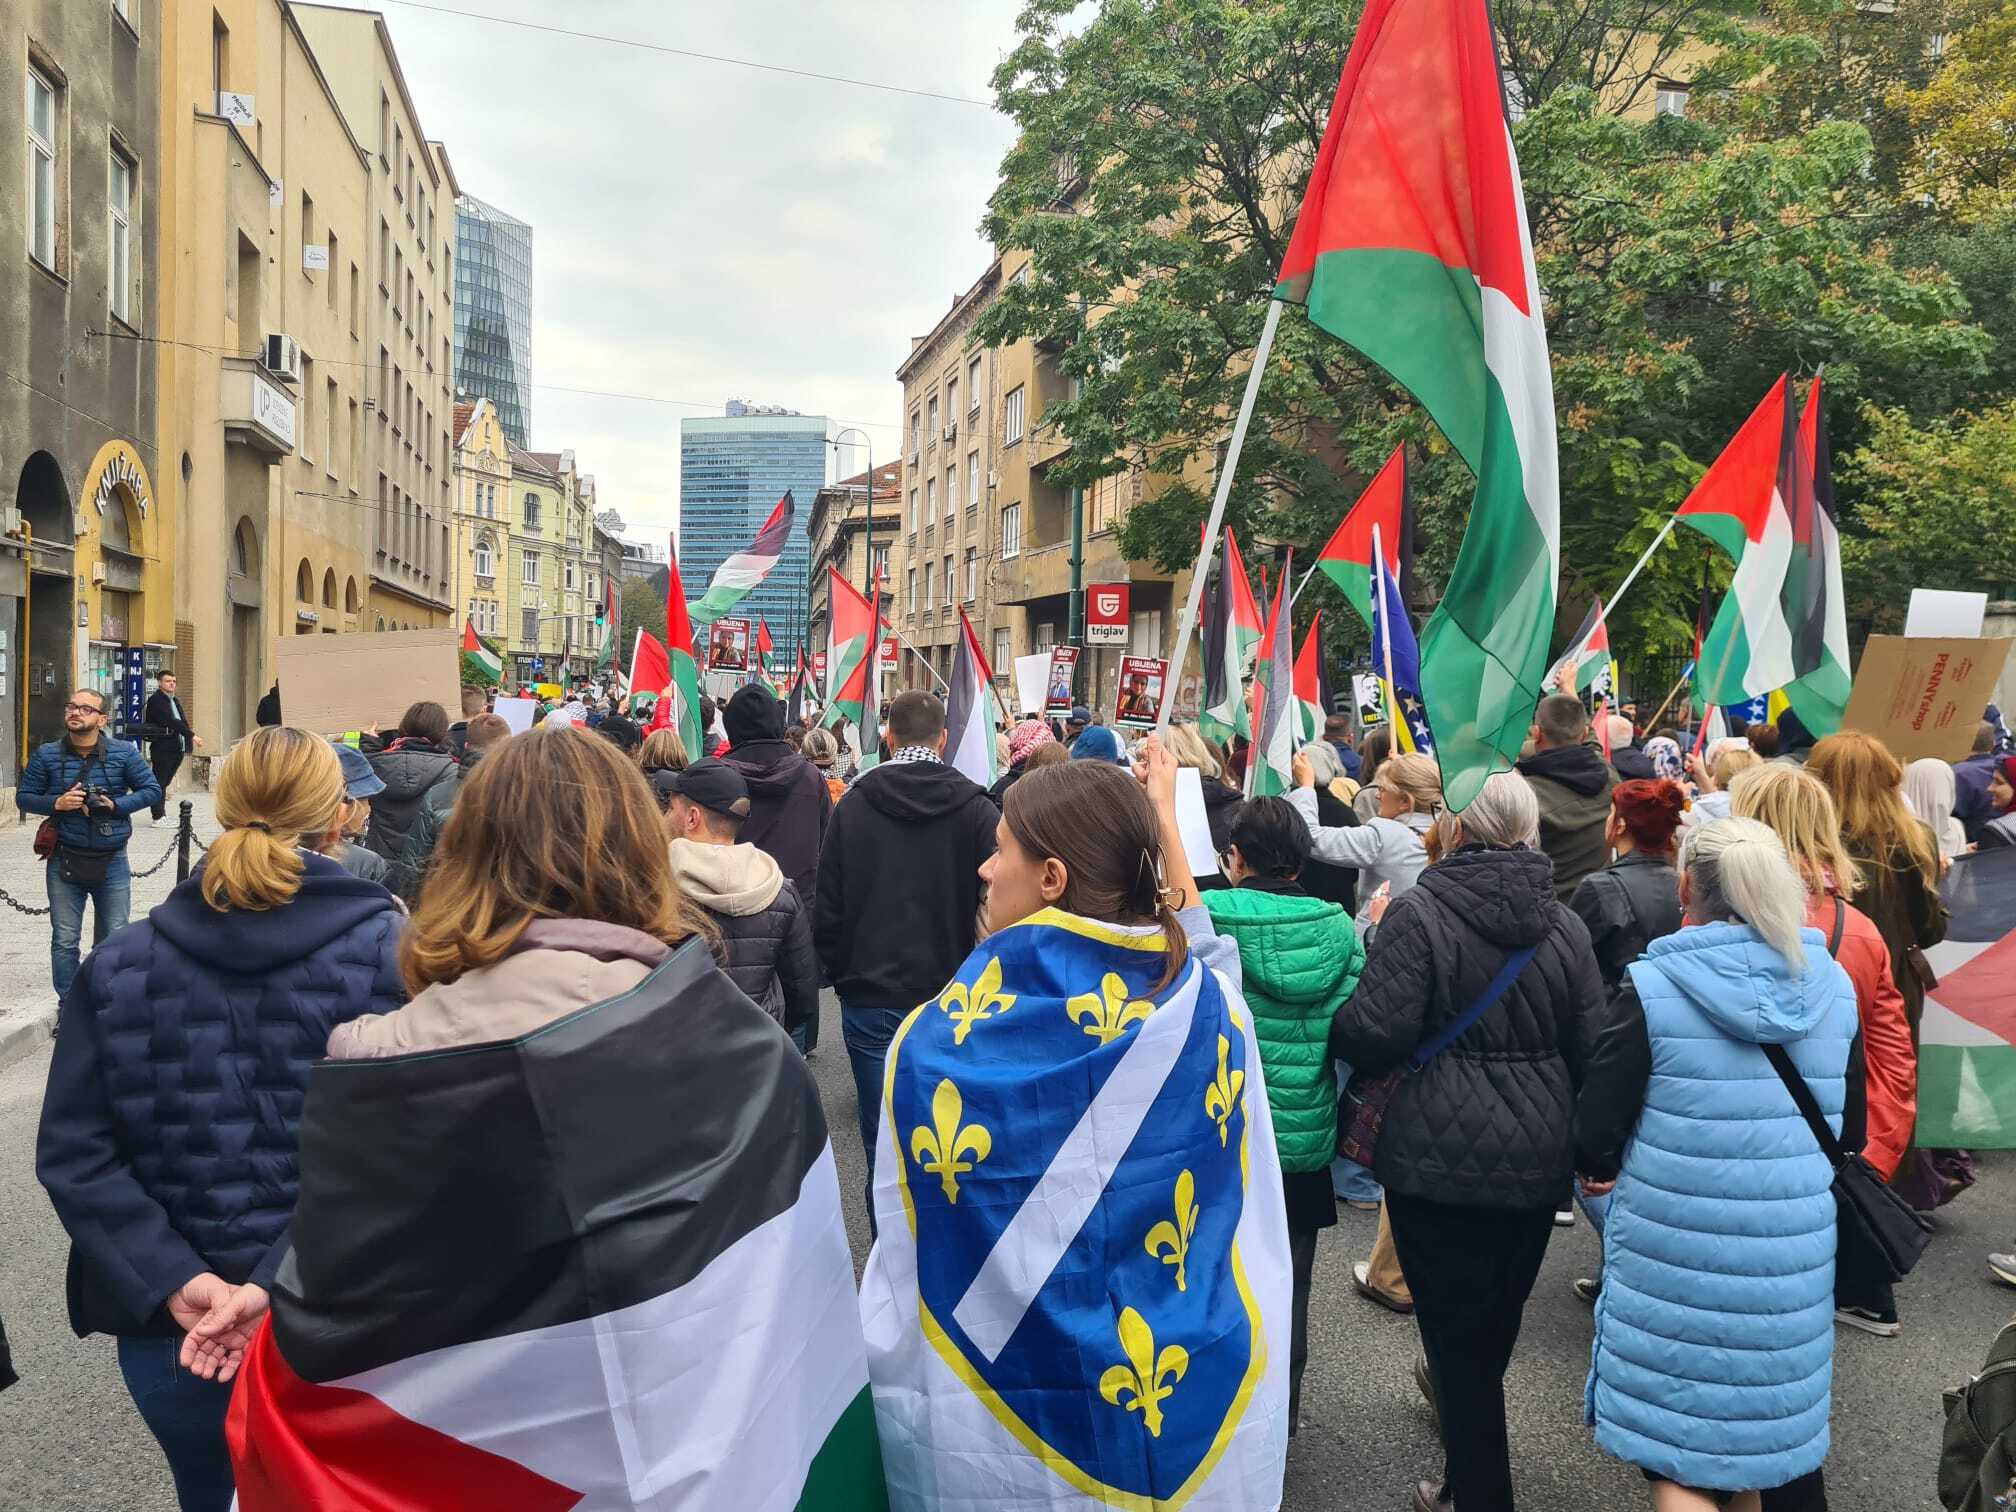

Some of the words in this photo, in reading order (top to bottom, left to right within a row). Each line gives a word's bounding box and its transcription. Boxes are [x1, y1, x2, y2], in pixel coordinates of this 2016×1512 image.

[94, 449, 148, 520] KNJIŽARA
[1091, 625, 1125, 638] triglav
[1129, 659, 1162, 670] UBIJENA
